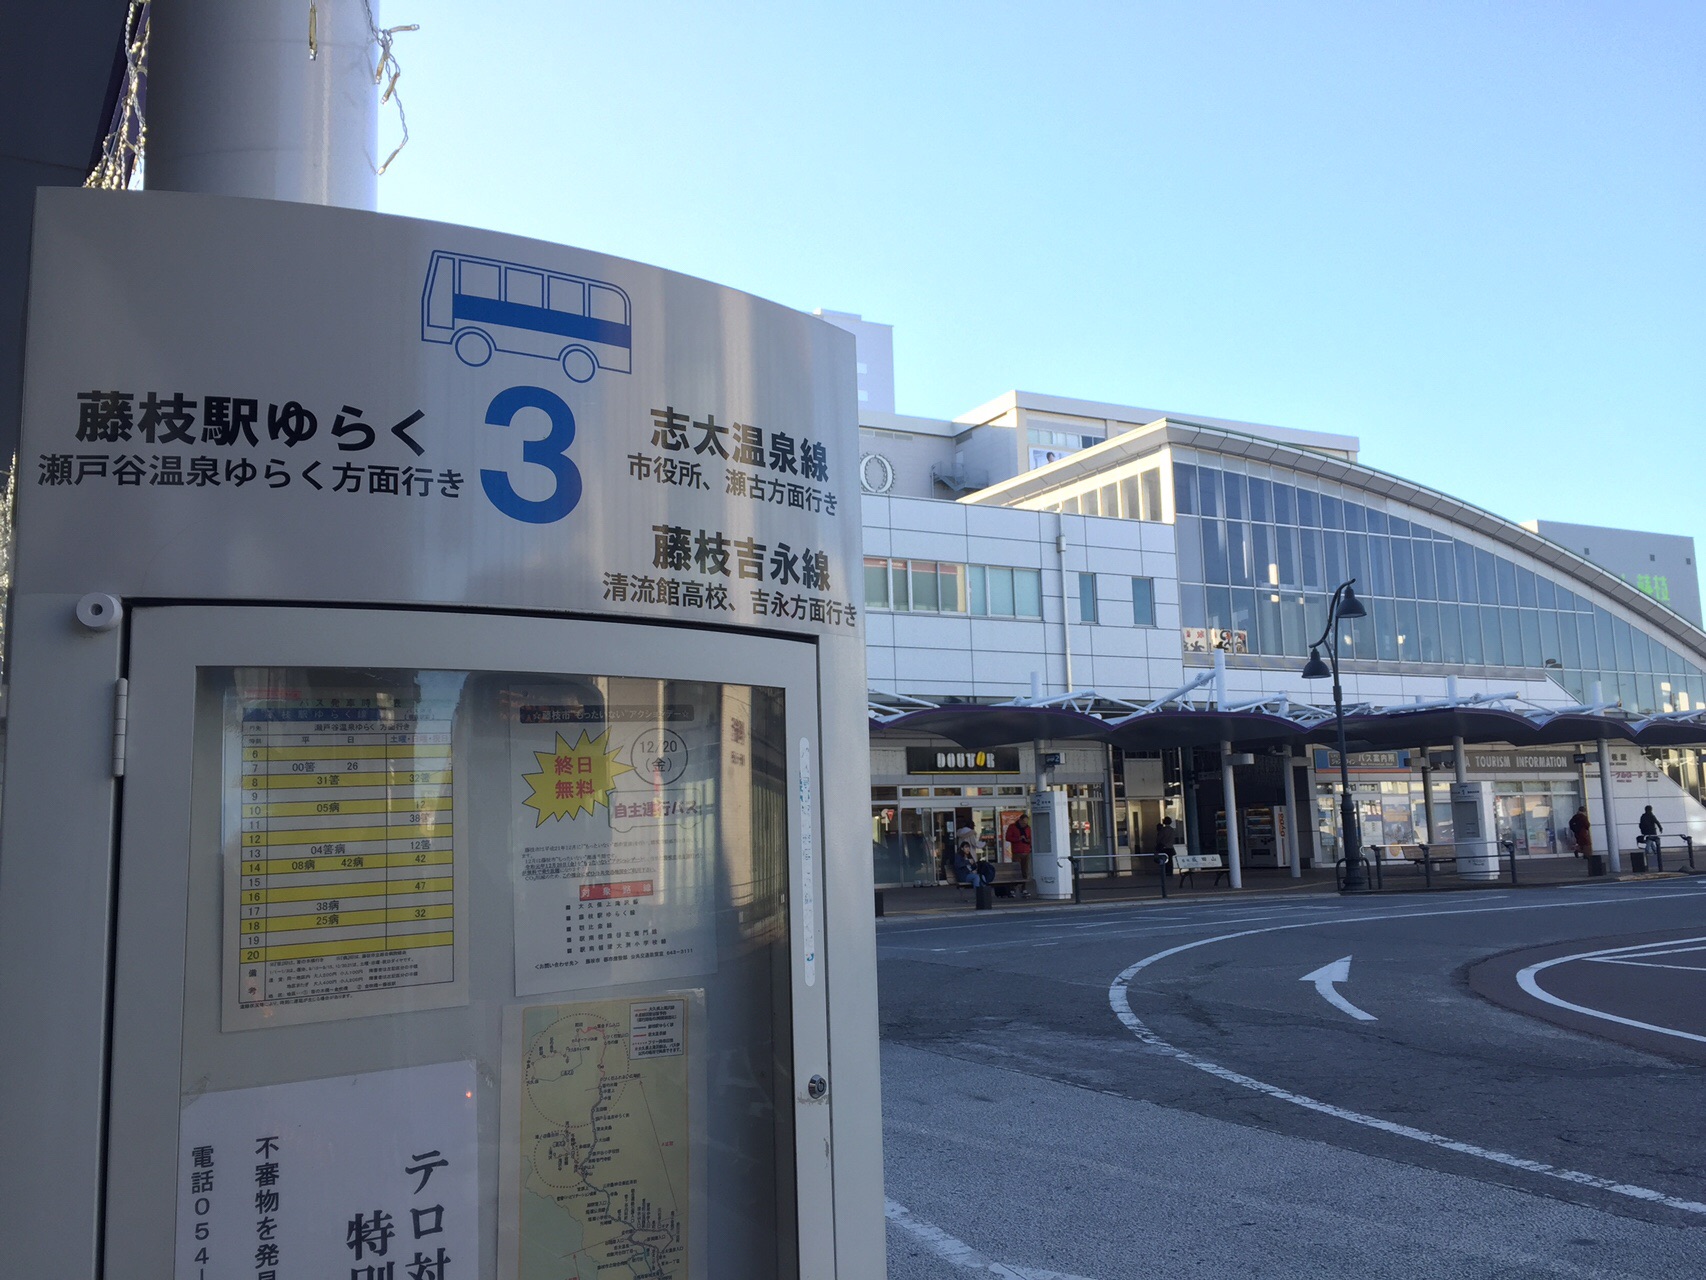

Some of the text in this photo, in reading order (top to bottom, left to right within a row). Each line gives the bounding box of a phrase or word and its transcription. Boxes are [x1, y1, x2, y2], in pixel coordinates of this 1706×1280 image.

[75, 390, 426, 457] 藤枝駅ゆらく
[650, 406, 829, 483] 志太温泉線
[481, 386, 582, 524] 3
[37, 453, 465, 498] 瀬戸谷温泉ゆらく方面行き
[651, 523, 831, 591] 藤枝吉永線
[639, 740, 677, 753] 12/20
[252, 750, 259, 759] 6
[1358, 753, 1395, 762] バス案内所
[936, 751, 995, 768] DOUTOR
[1475, 756, 1511, 768] TOURISM
[1516, 756, 1568, 768] INFORMATION
[252, 763, 258, 773] 7
[346, 762, 358, 771] 26
[554, 756, 592, 775] 終日
[252, 778, 258, 787] 8
[555, 779, 595, 799] 無料
[252, 792, 258, 801] 9
[249, 806, 261, 815] 10
[249, 821, 260, 830] 11
[249, 835, 261, 844] 12
[249, 849, 261, 858] 13
[415, 854, 426, 863] 42
[249, 863, 261, 873] 14
[249, 878, 261, 887] 15
[415, 881, 426, 890] 47
[248, 892, 260, 902] 16
[248, 907, 260, 916] 17
[414, 909, 426, 918] 32
[248, 921, 260, 931] 18
[248, 936, 260, 945] 19
[247, 951, 260, 960] 20
